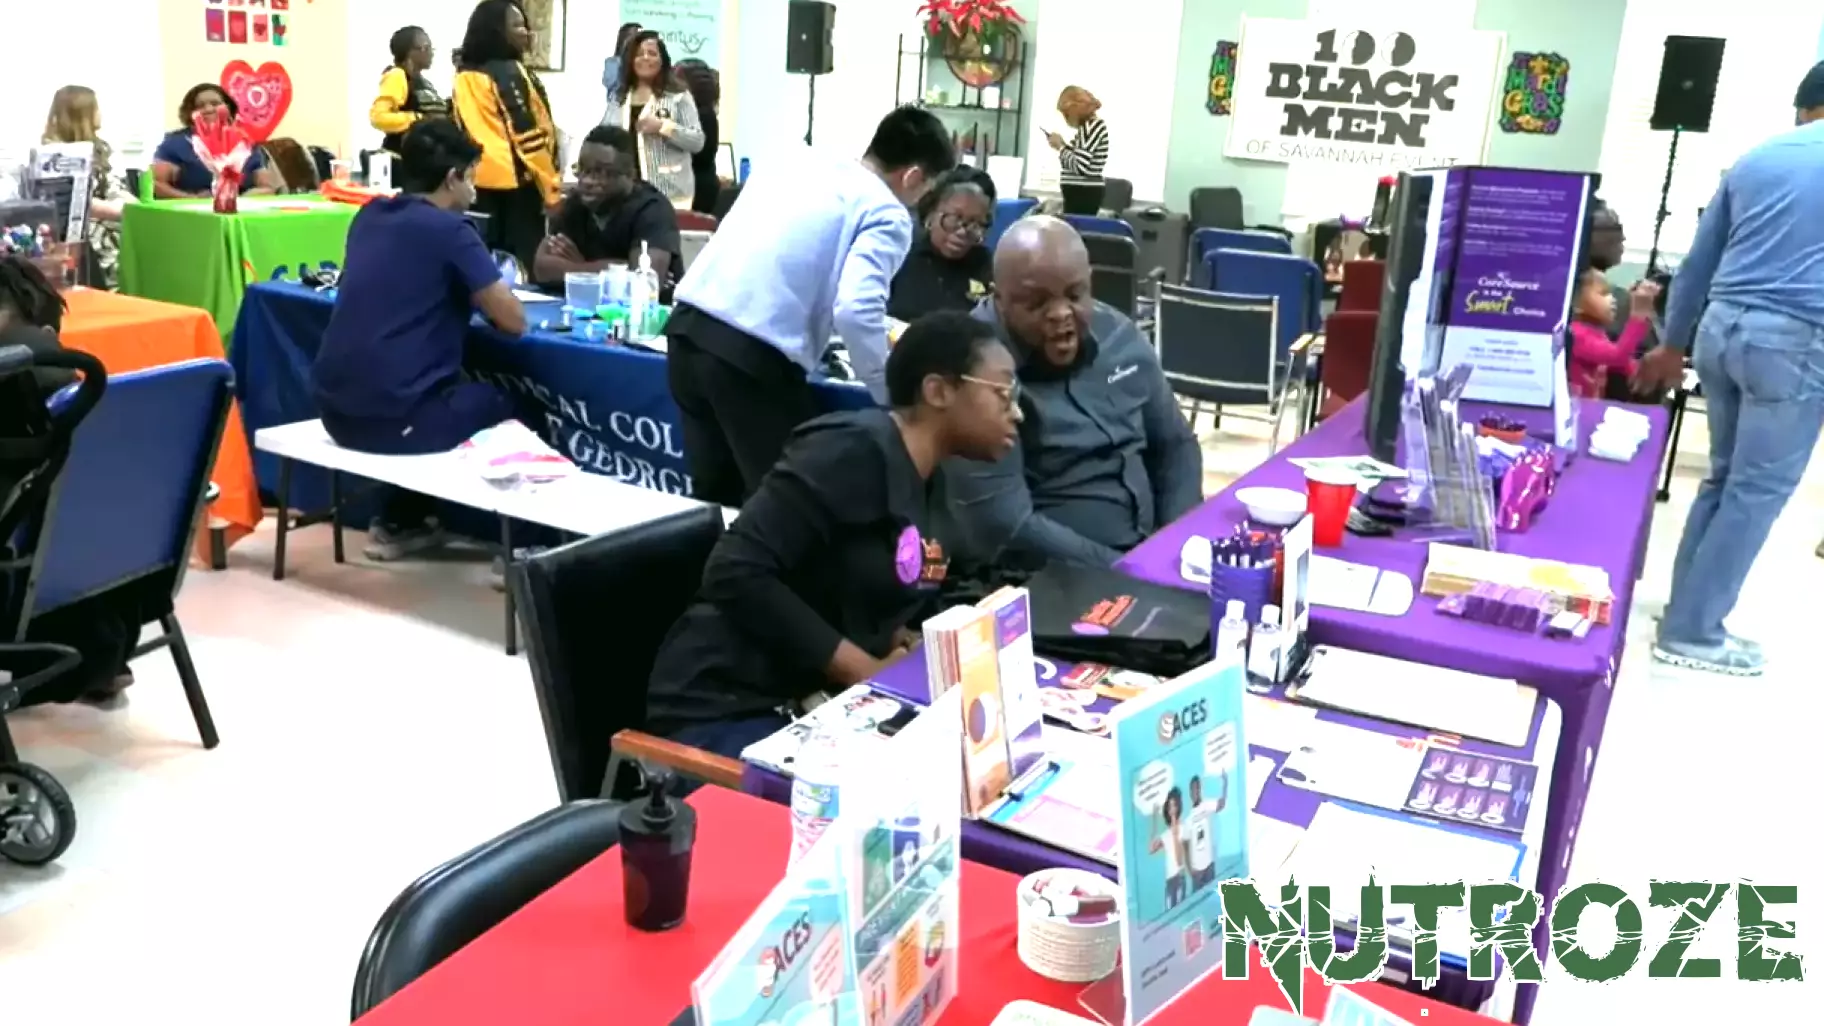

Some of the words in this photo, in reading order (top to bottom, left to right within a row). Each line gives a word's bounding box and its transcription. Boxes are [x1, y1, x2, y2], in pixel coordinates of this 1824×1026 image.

[1313, 28, 1416, 67] 100
[1265, 62, 1459, 112] BLACK
[1280, 103, 1430, 147] MEN
[1246, 139, 1271, 154] OF
[1278, 141, 1384, 166] SAVANNAH
[1465, 290, 1515, 316] Smart
[609, 410, 684, 459] COL
[568, 429, 696, 497] GEORGI
